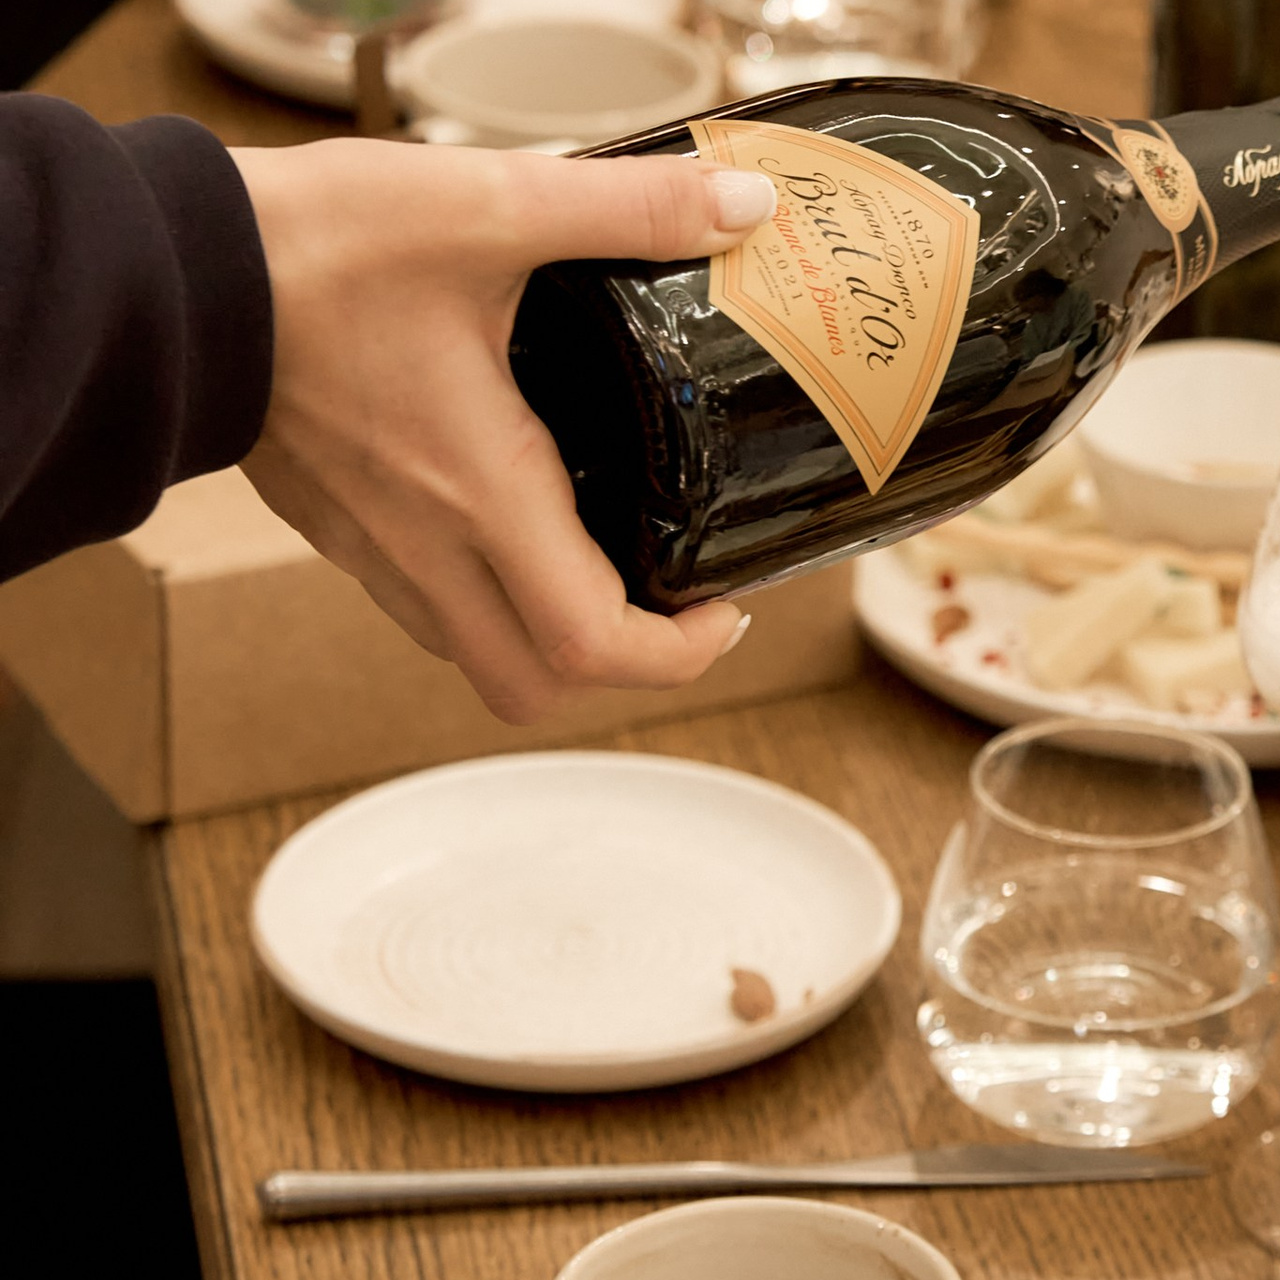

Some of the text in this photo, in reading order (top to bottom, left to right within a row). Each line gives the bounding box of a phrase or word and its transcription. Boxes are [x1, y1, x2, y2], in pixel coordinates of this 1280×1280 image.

[757, 157, 907, 372] Brut d'Or
[766, 243, 804, 301] 2021
[771, 203, 847, 357] Blanc de Blancs
[838, 178, 917, 321] Абрау-Дюрсо
[902, 208, 934, 260] 1870
